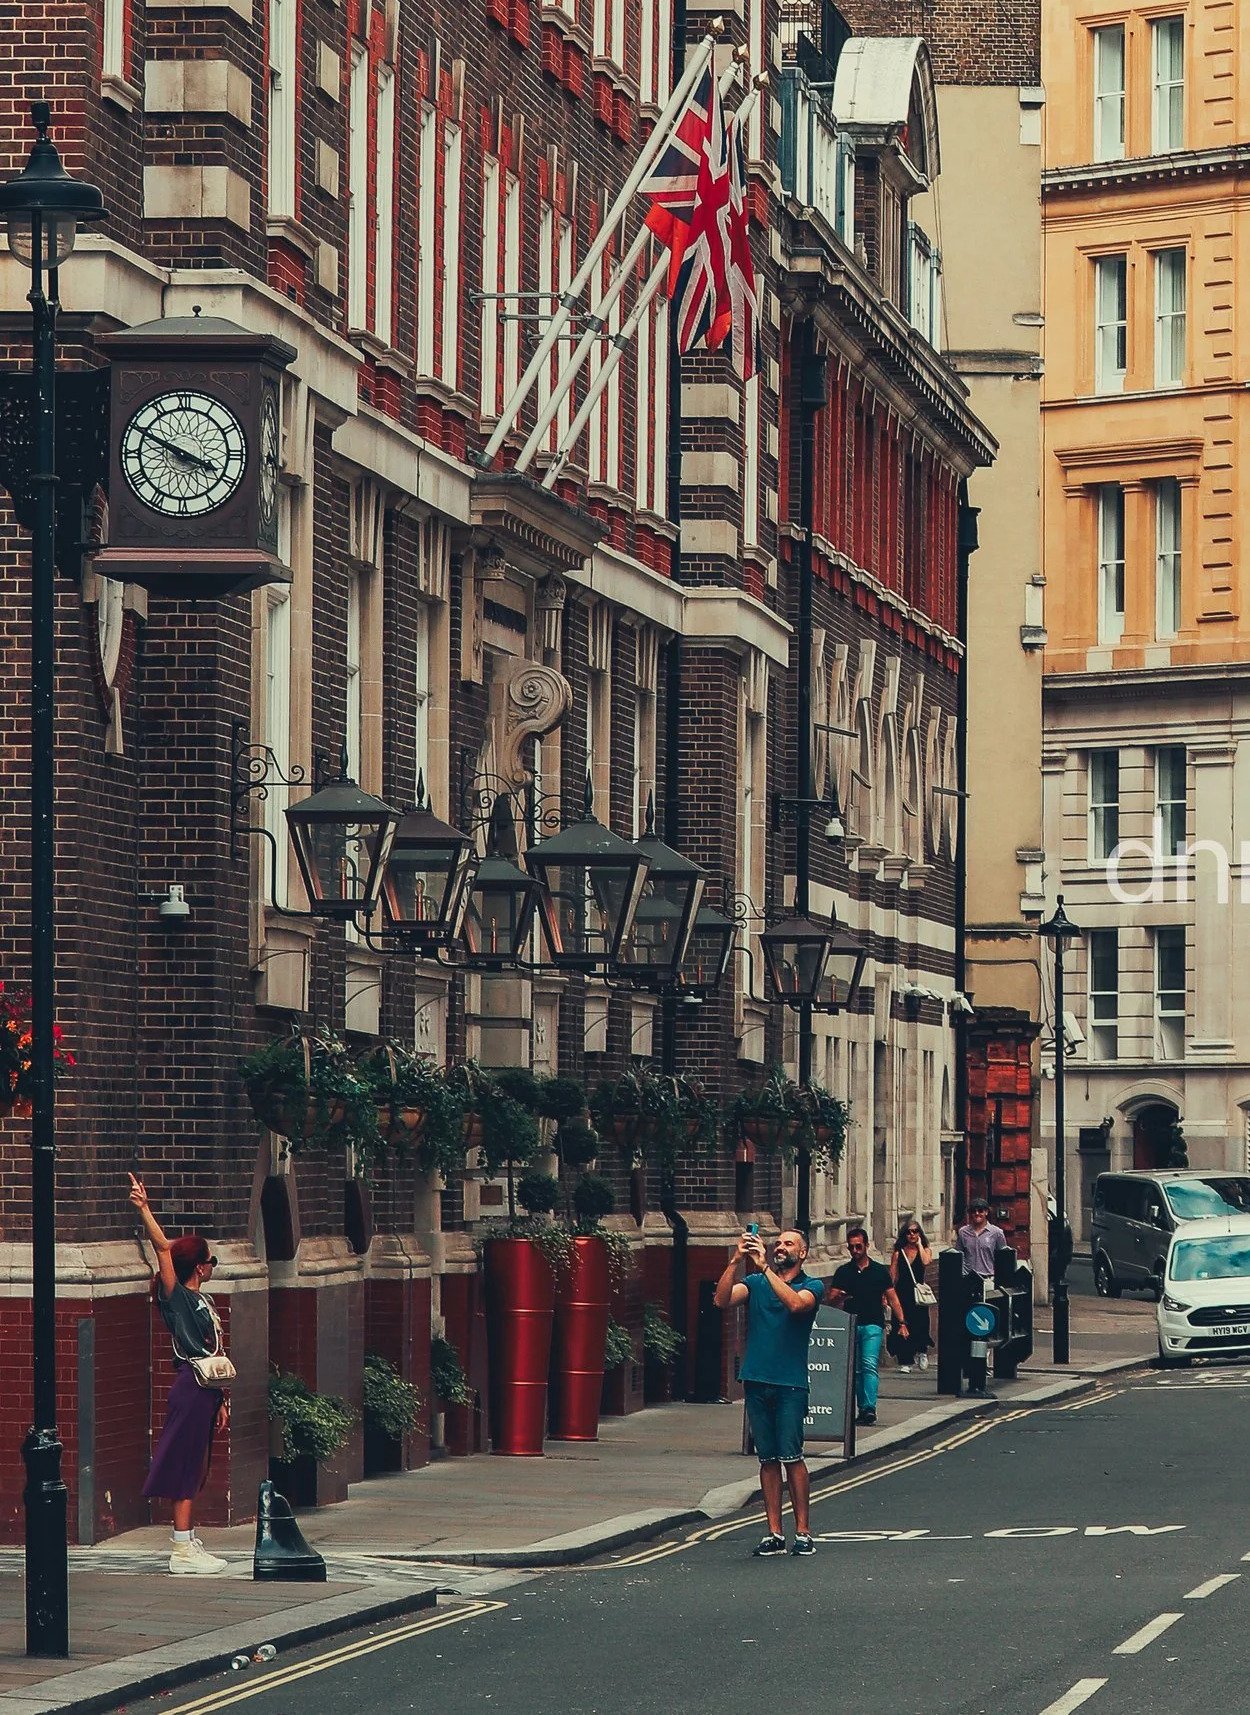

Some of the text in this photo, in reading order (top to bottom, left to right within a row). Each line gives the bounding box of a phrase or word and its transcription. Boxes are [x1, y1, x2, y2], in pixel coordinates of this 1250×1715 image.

[1212, 1325, 1248, 1336] HY19 WGV
[814, 1525, 1188, 1542] SLOW
